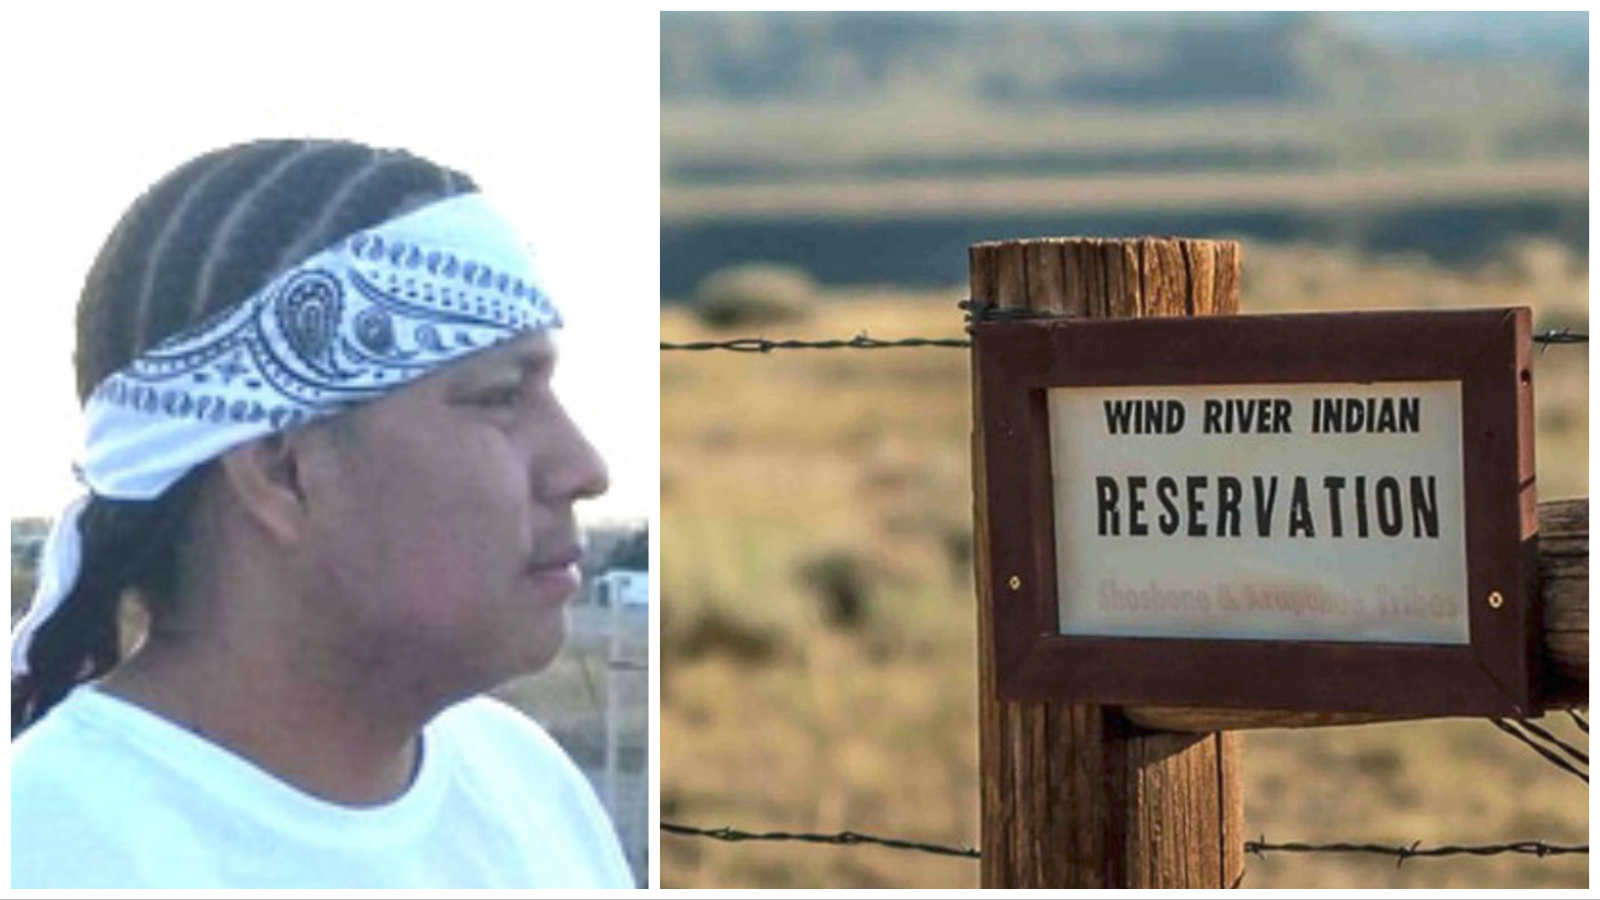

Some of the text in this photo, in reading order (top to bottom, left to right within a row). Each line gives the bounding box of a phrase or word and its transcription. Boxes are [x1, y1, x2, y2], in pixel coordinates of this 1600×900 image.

[1103, 397, 1420, 435] WIND RIVER INDIAN
[1095, 475, 1440, 538] RESERVATION
